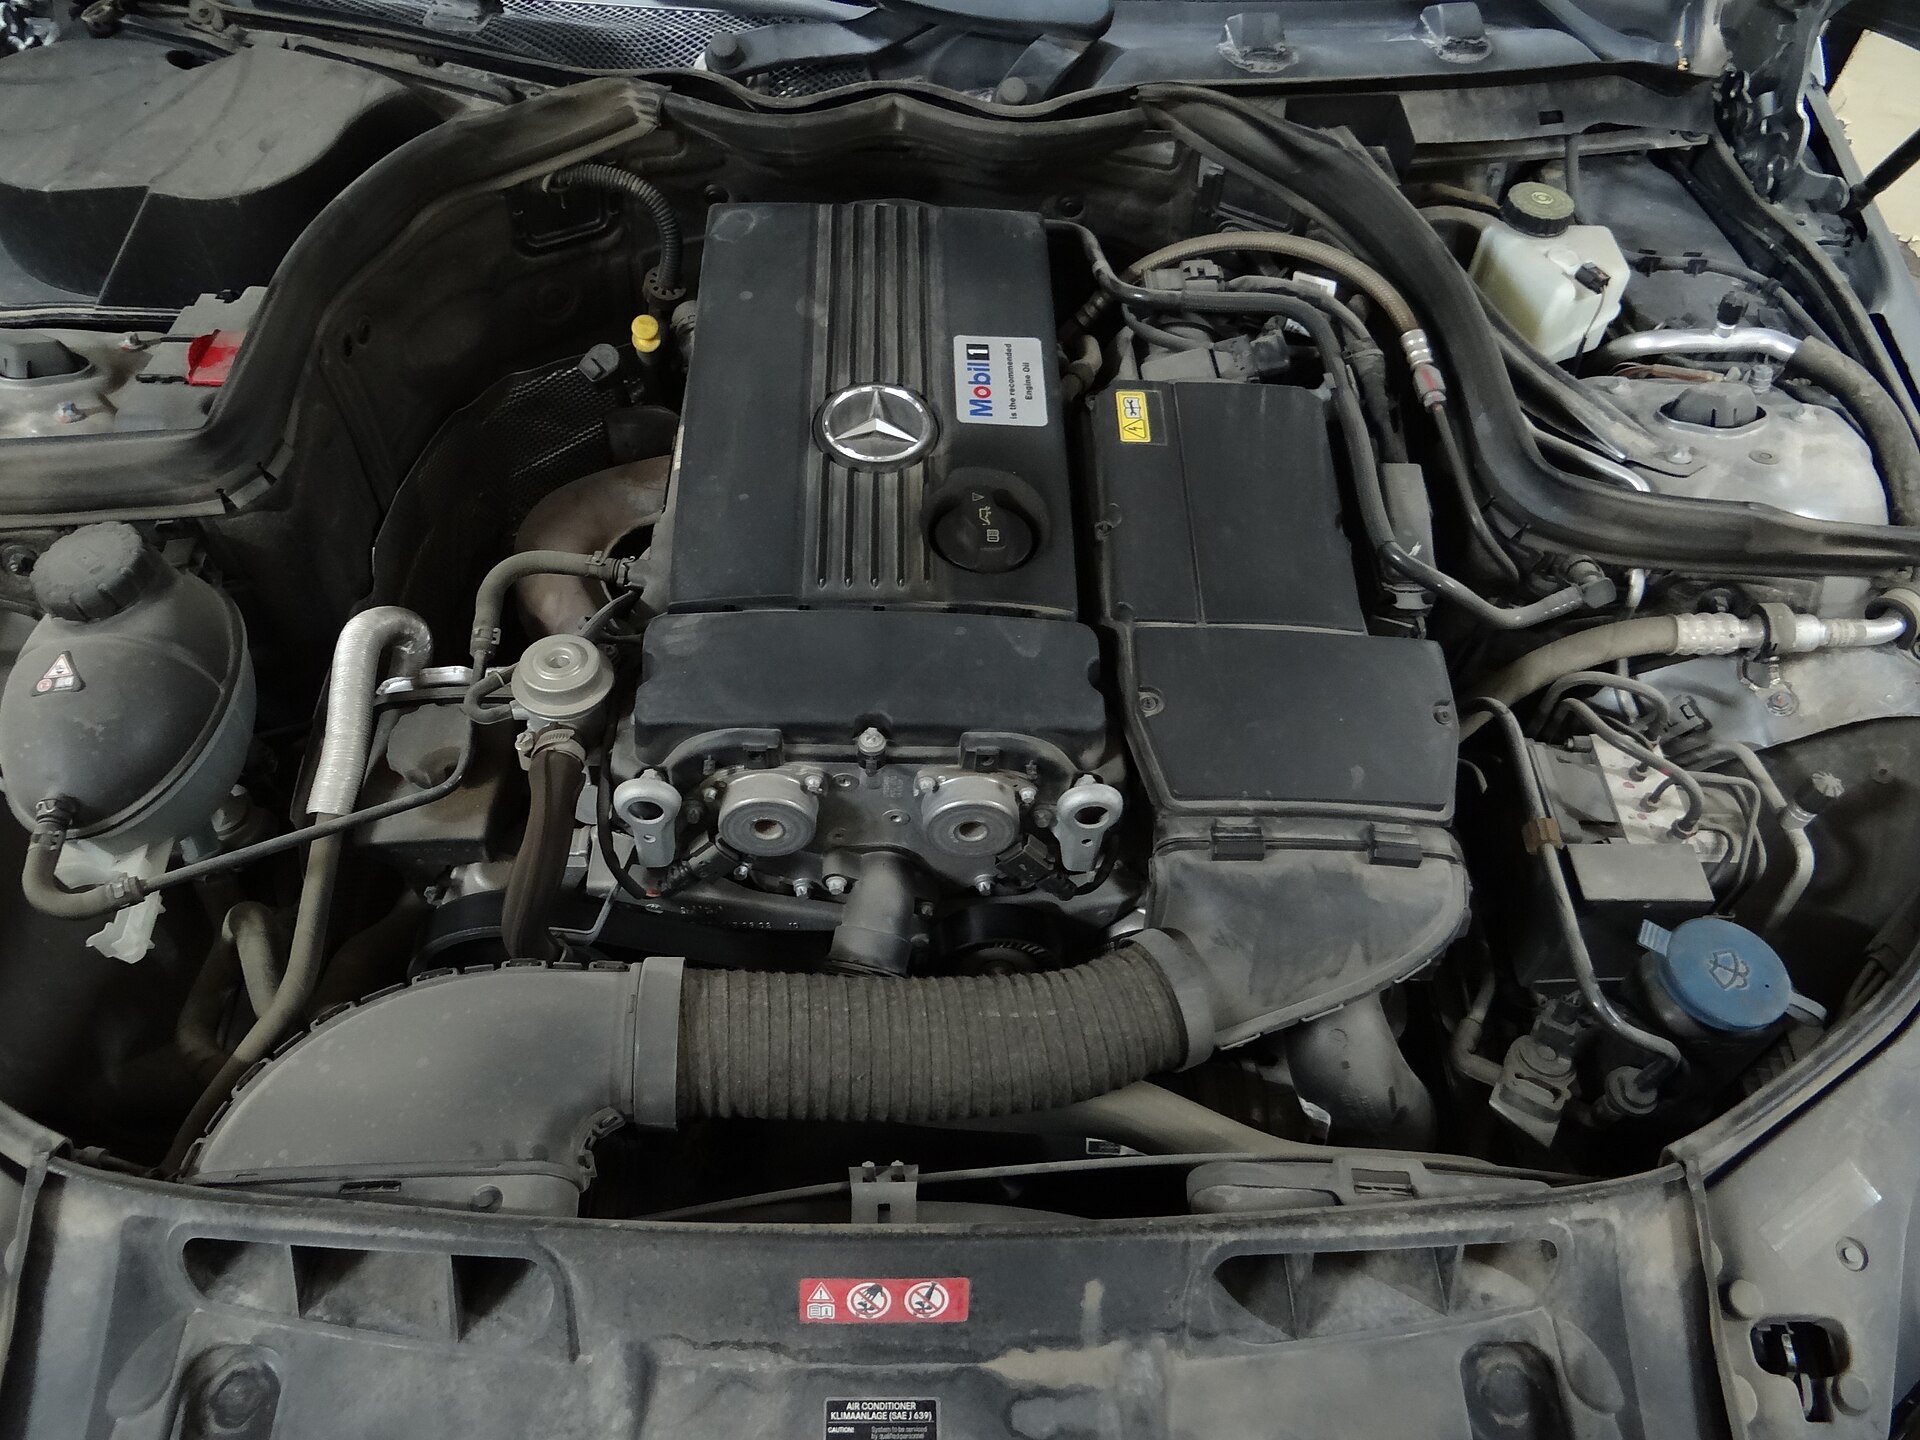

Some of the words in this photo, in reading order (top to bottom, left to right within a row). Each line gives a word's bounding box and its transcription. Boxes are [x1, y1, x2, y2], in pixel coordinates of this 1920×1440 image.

[1004, 343, 1016, 396] recommended
[1022, 362, 1031, 373] Oil
[967, 362, 993, 417] Mobil
[1024, 375, 1034, 400] Engine
[1008, 398, 1017, 411] the
[846, 1401, 860, 1411] AIR
[861, 1401, 917, 1411] CONDITIONER
[830, 1411, 888, 1421] KLIMAANLAGE
[889, 1411, 907, 1421] (SAE
[913, 1411, 932, 1421] 639)
